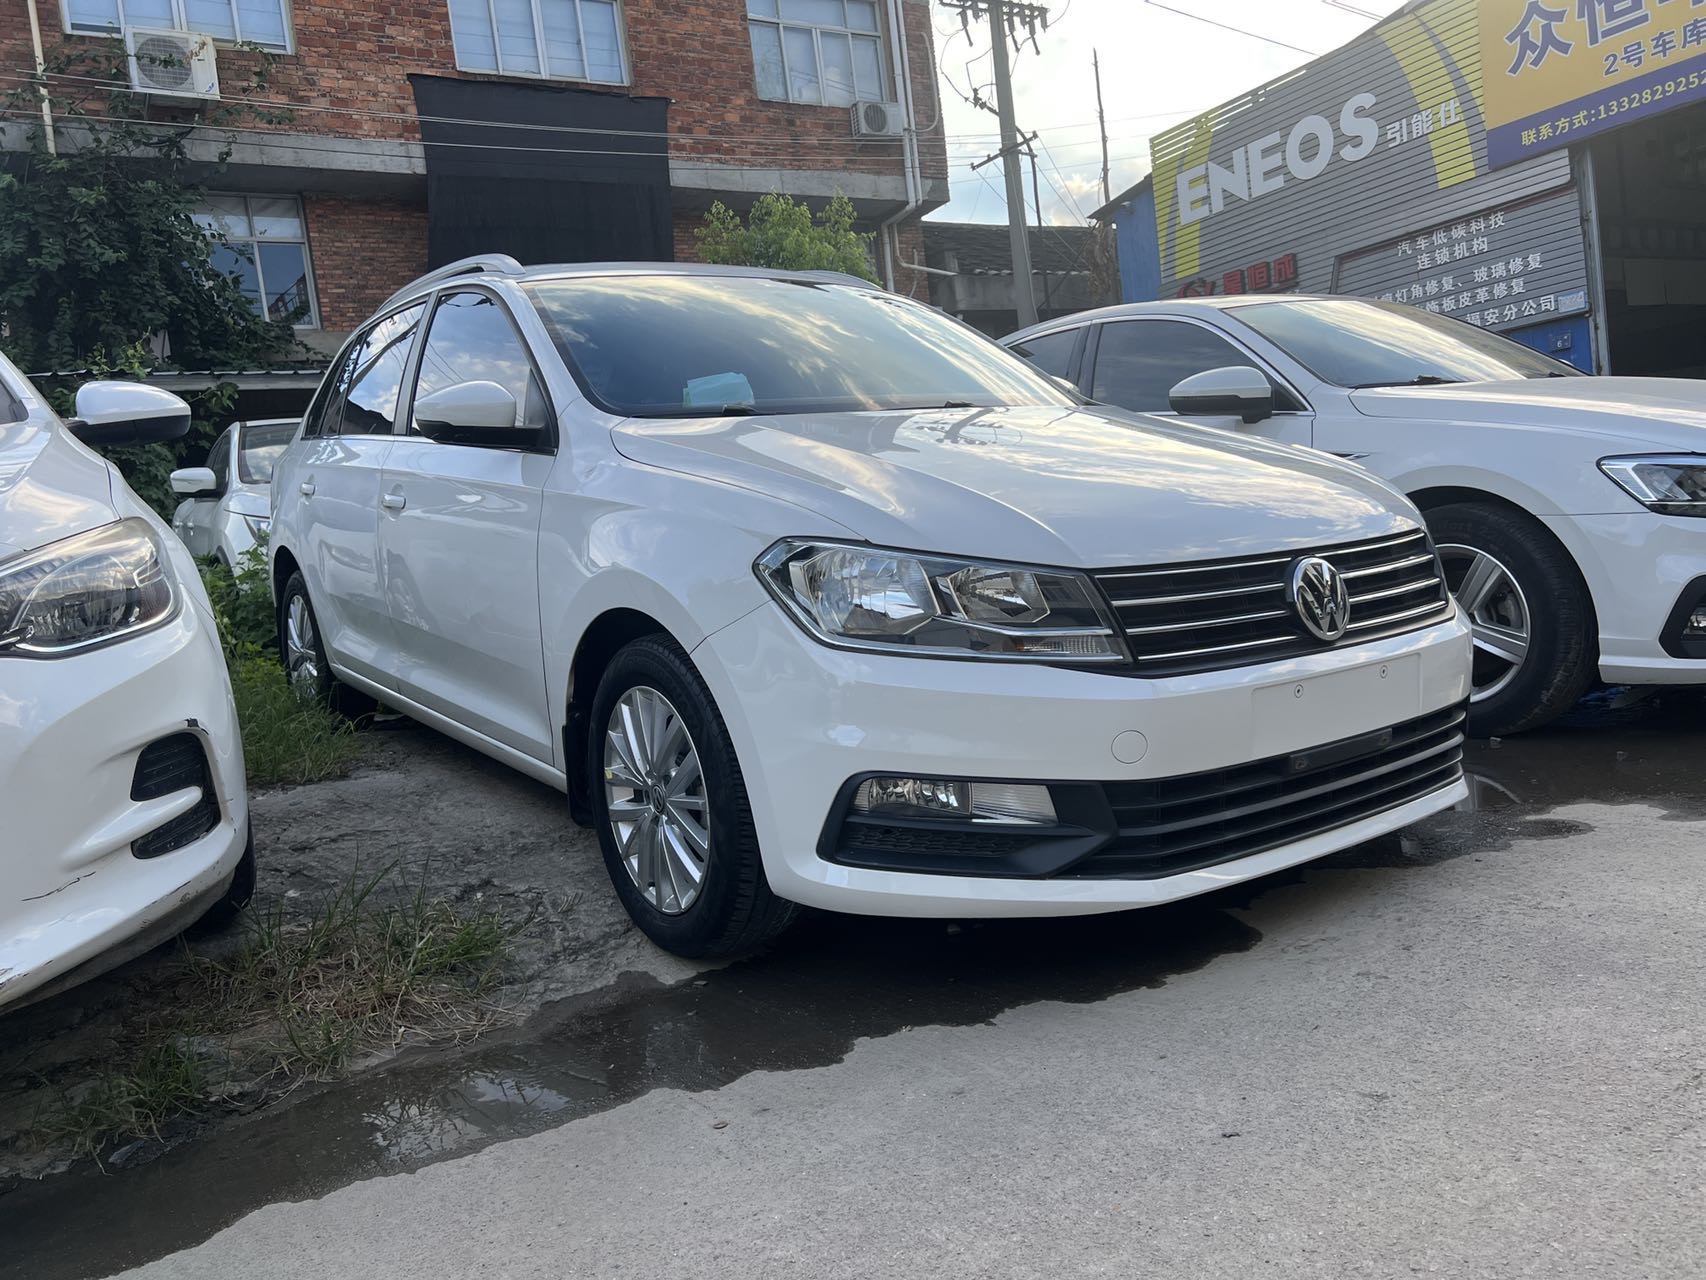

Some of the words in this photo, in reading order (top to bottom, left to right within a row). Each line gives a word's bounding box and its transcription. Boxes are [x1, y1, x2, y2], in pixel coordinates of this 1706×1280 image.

[1505, 0, 1706, 76] 众恒
[1603, 18, 1706, 77] 2号车库
[1386, 99, 1463, 148] 引能仕
[1176, 93, 1379, 225] ENEOS
[1397, 211, 1505, 257] 汽车低碳科技
[1416, 236, 1489, 270] 连锁机构
[1416, 278, 1526, 314] 饰板皮革修复
[1465, 294, 1555, 327] 福安分公司
